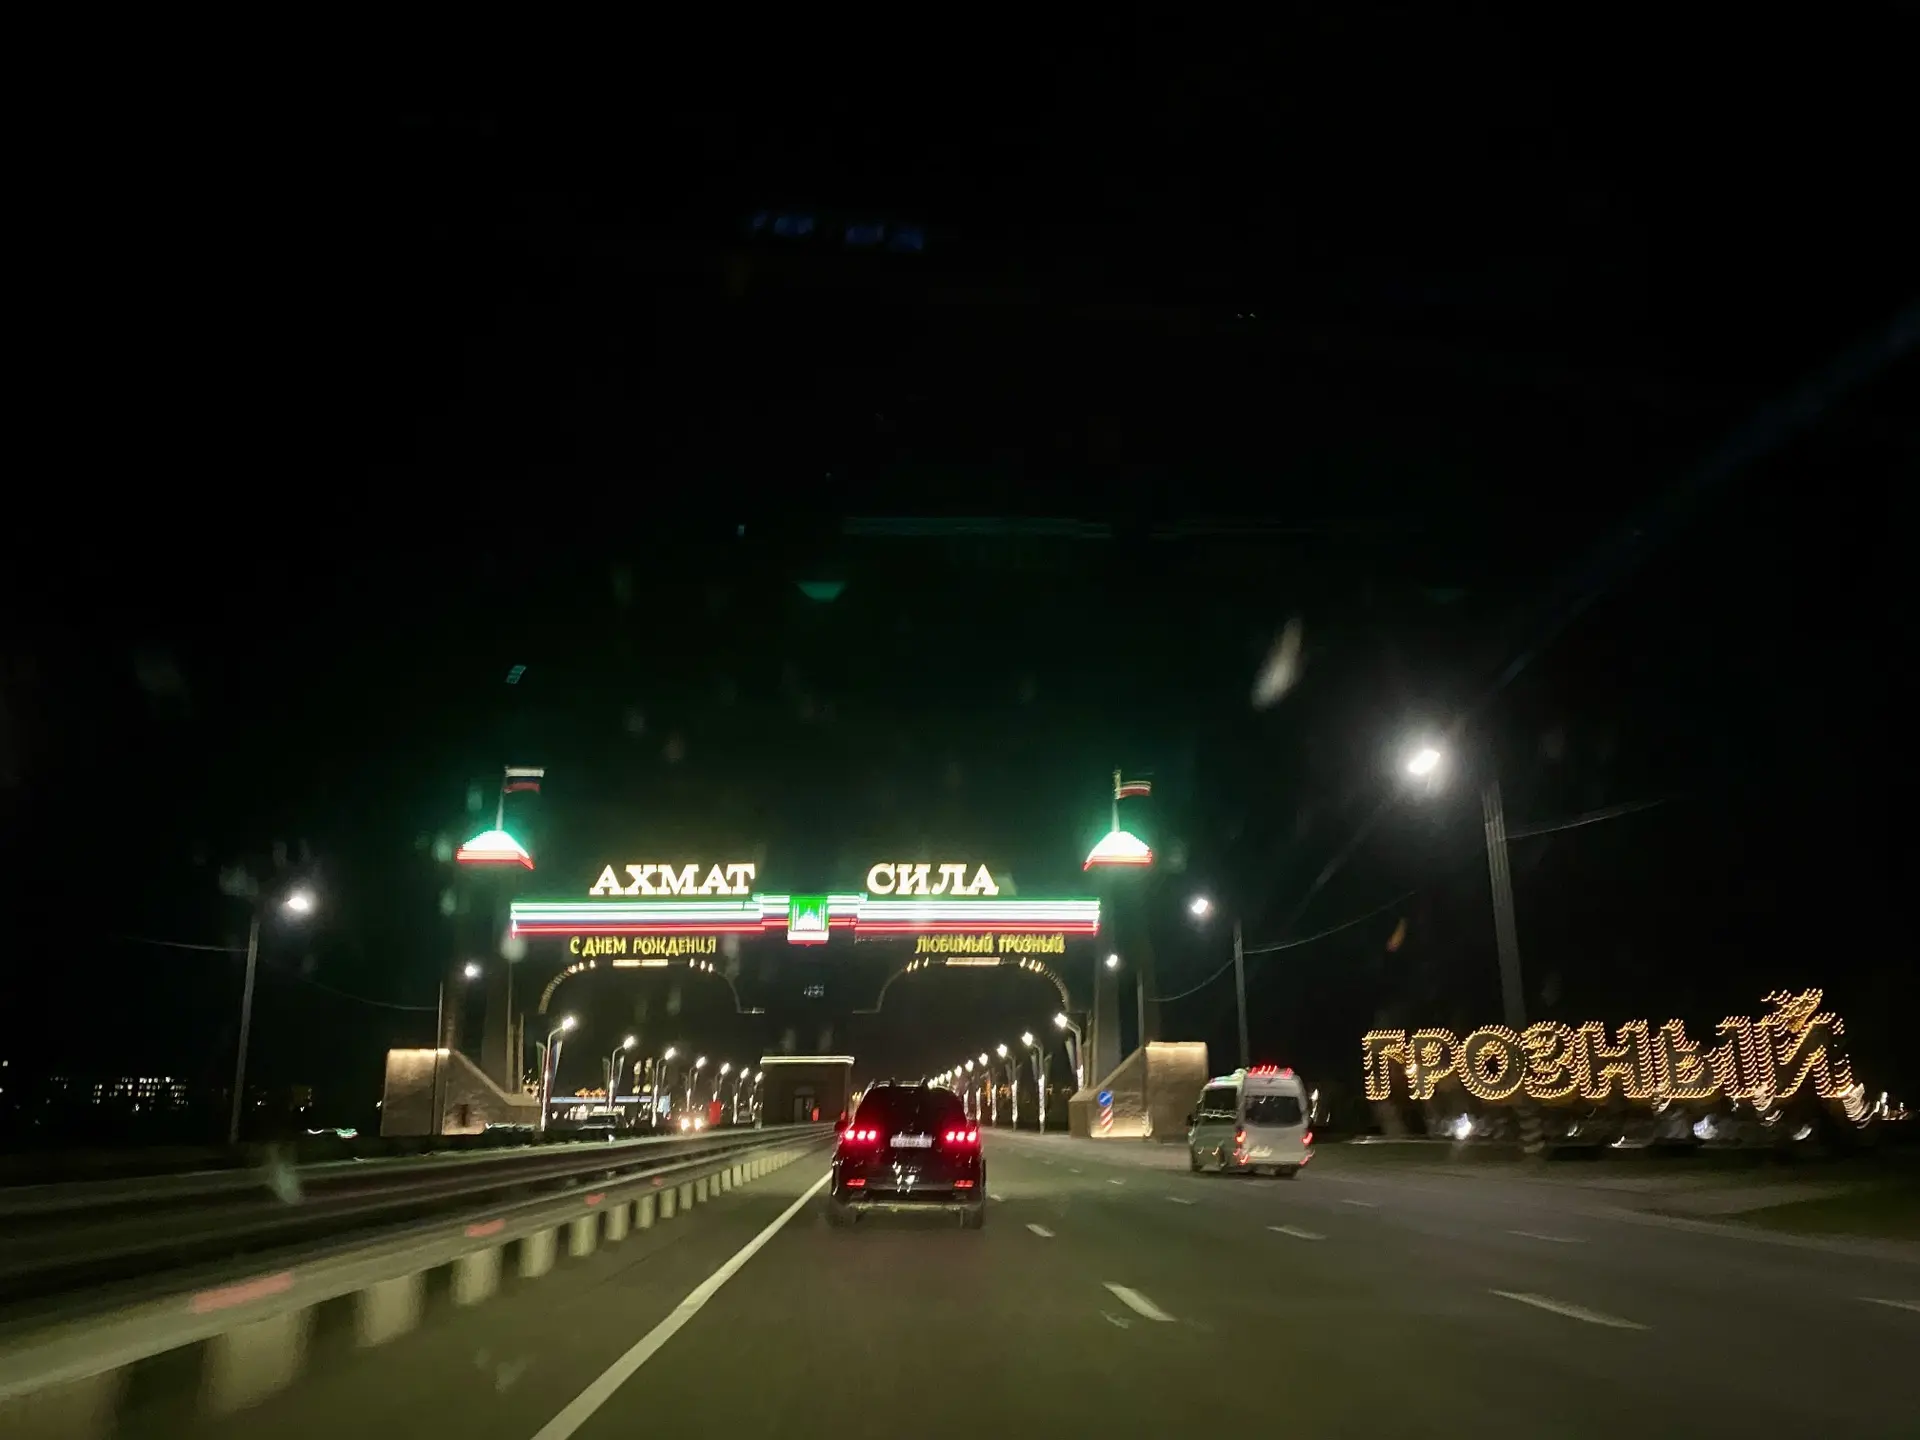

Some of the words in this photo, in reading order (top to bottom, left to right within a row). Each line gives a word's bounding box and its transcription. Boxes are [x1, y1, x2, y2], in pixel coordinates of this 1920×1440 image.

[589, 863, 756, 896] АХМАТ
[866, 862, 1000, 896] СИЛА
[569, 935, 580, 955] С
[633, 936, 717, 957] РОЖДЕНИЯ
[915, 932, 995, 954] ЛЮБИМЫЙ
[998, 932, 1065, 954] ГРОЗНЫЙ
[1362, 988, 1856, 1101] ГРОЗНЫЙ
